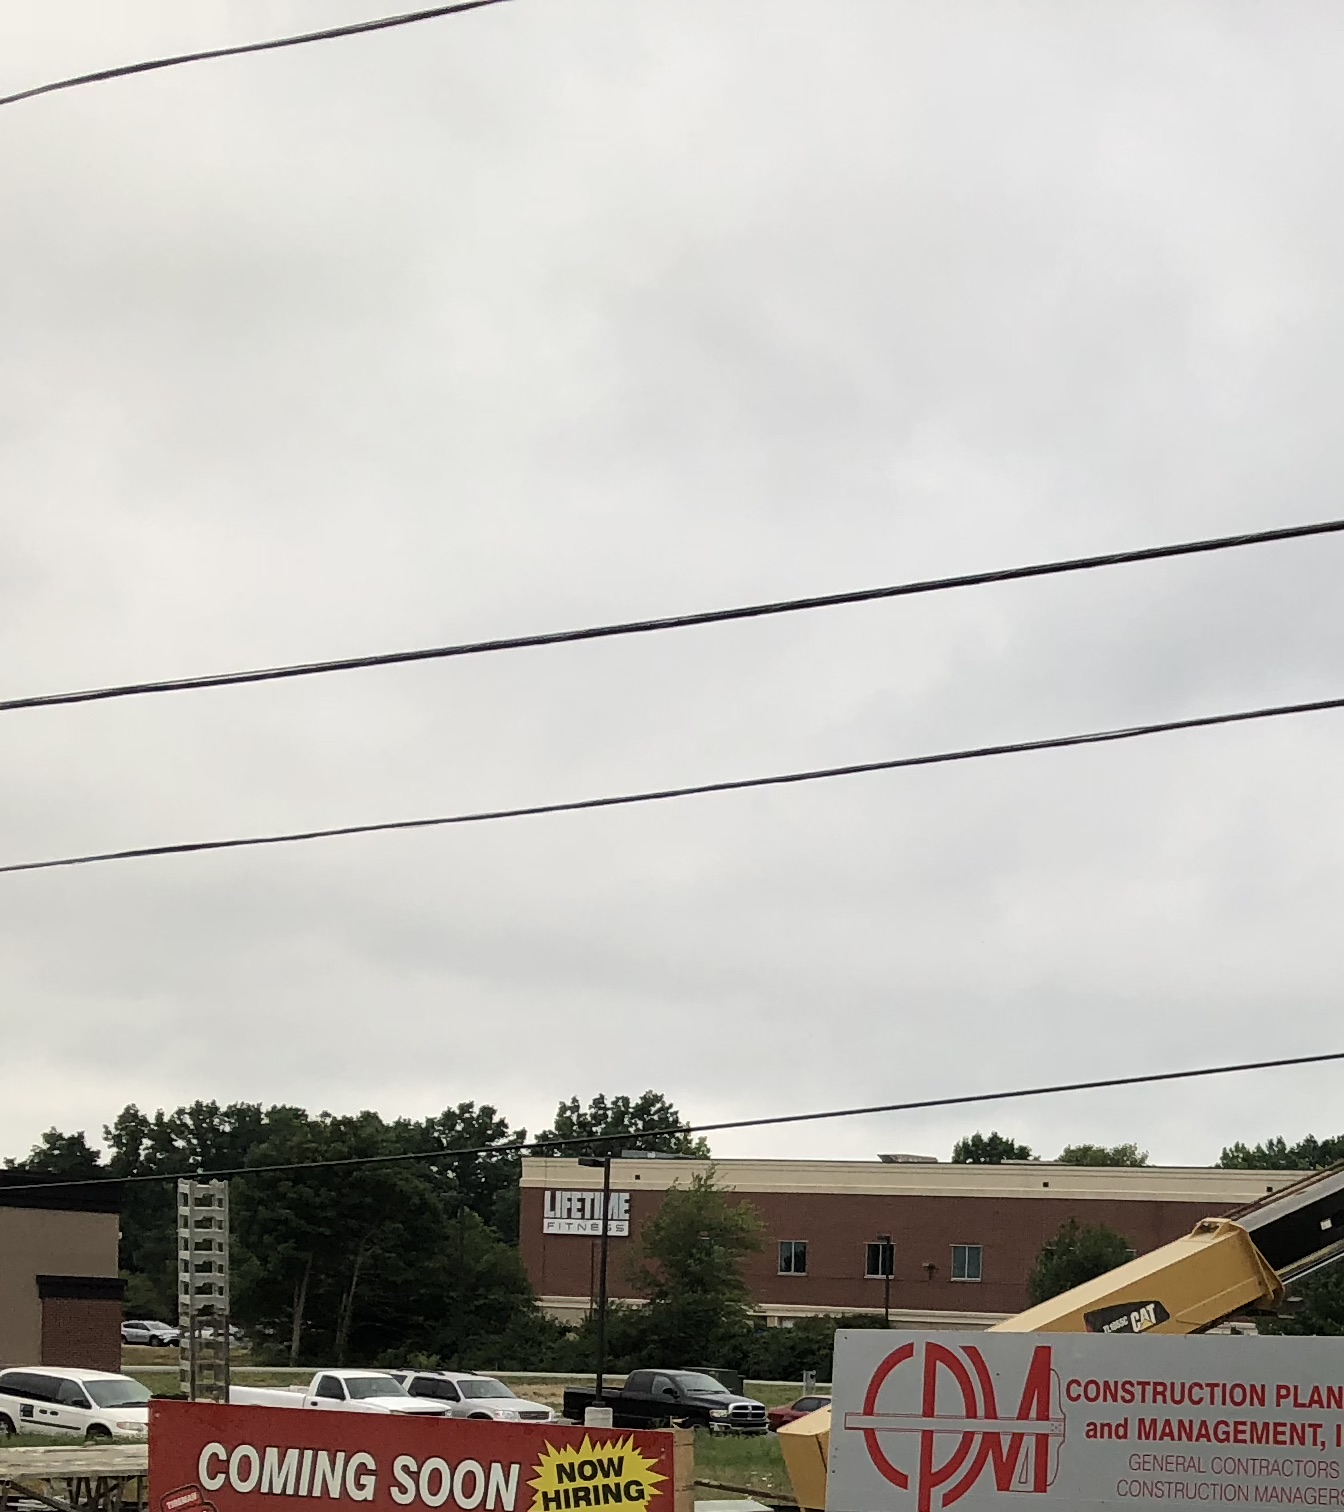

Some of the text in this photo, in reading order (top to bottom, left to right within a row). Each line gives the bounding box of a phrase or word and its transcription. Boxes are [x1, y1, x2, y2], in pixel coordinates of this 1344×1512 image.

[1130, 1303, 1157, 1333] CAT
[1065, 1379, 1266, 1407] CONSTRUCTION
[1085, 1417, 1129, 1441] and
[1137, 1418, 1326, 1451] MANAGEMENT,
[199, 1442, 520, 1512] COMING SOON
[556, 1456, 625, 1484] NOW
[1129, 1454, 1340, 1479] GENERAL CONTRACTORS
[541, 1480, 645, 1512] HIRING
[1117, 1480, 1249, 1502] CONSTRUCTION
